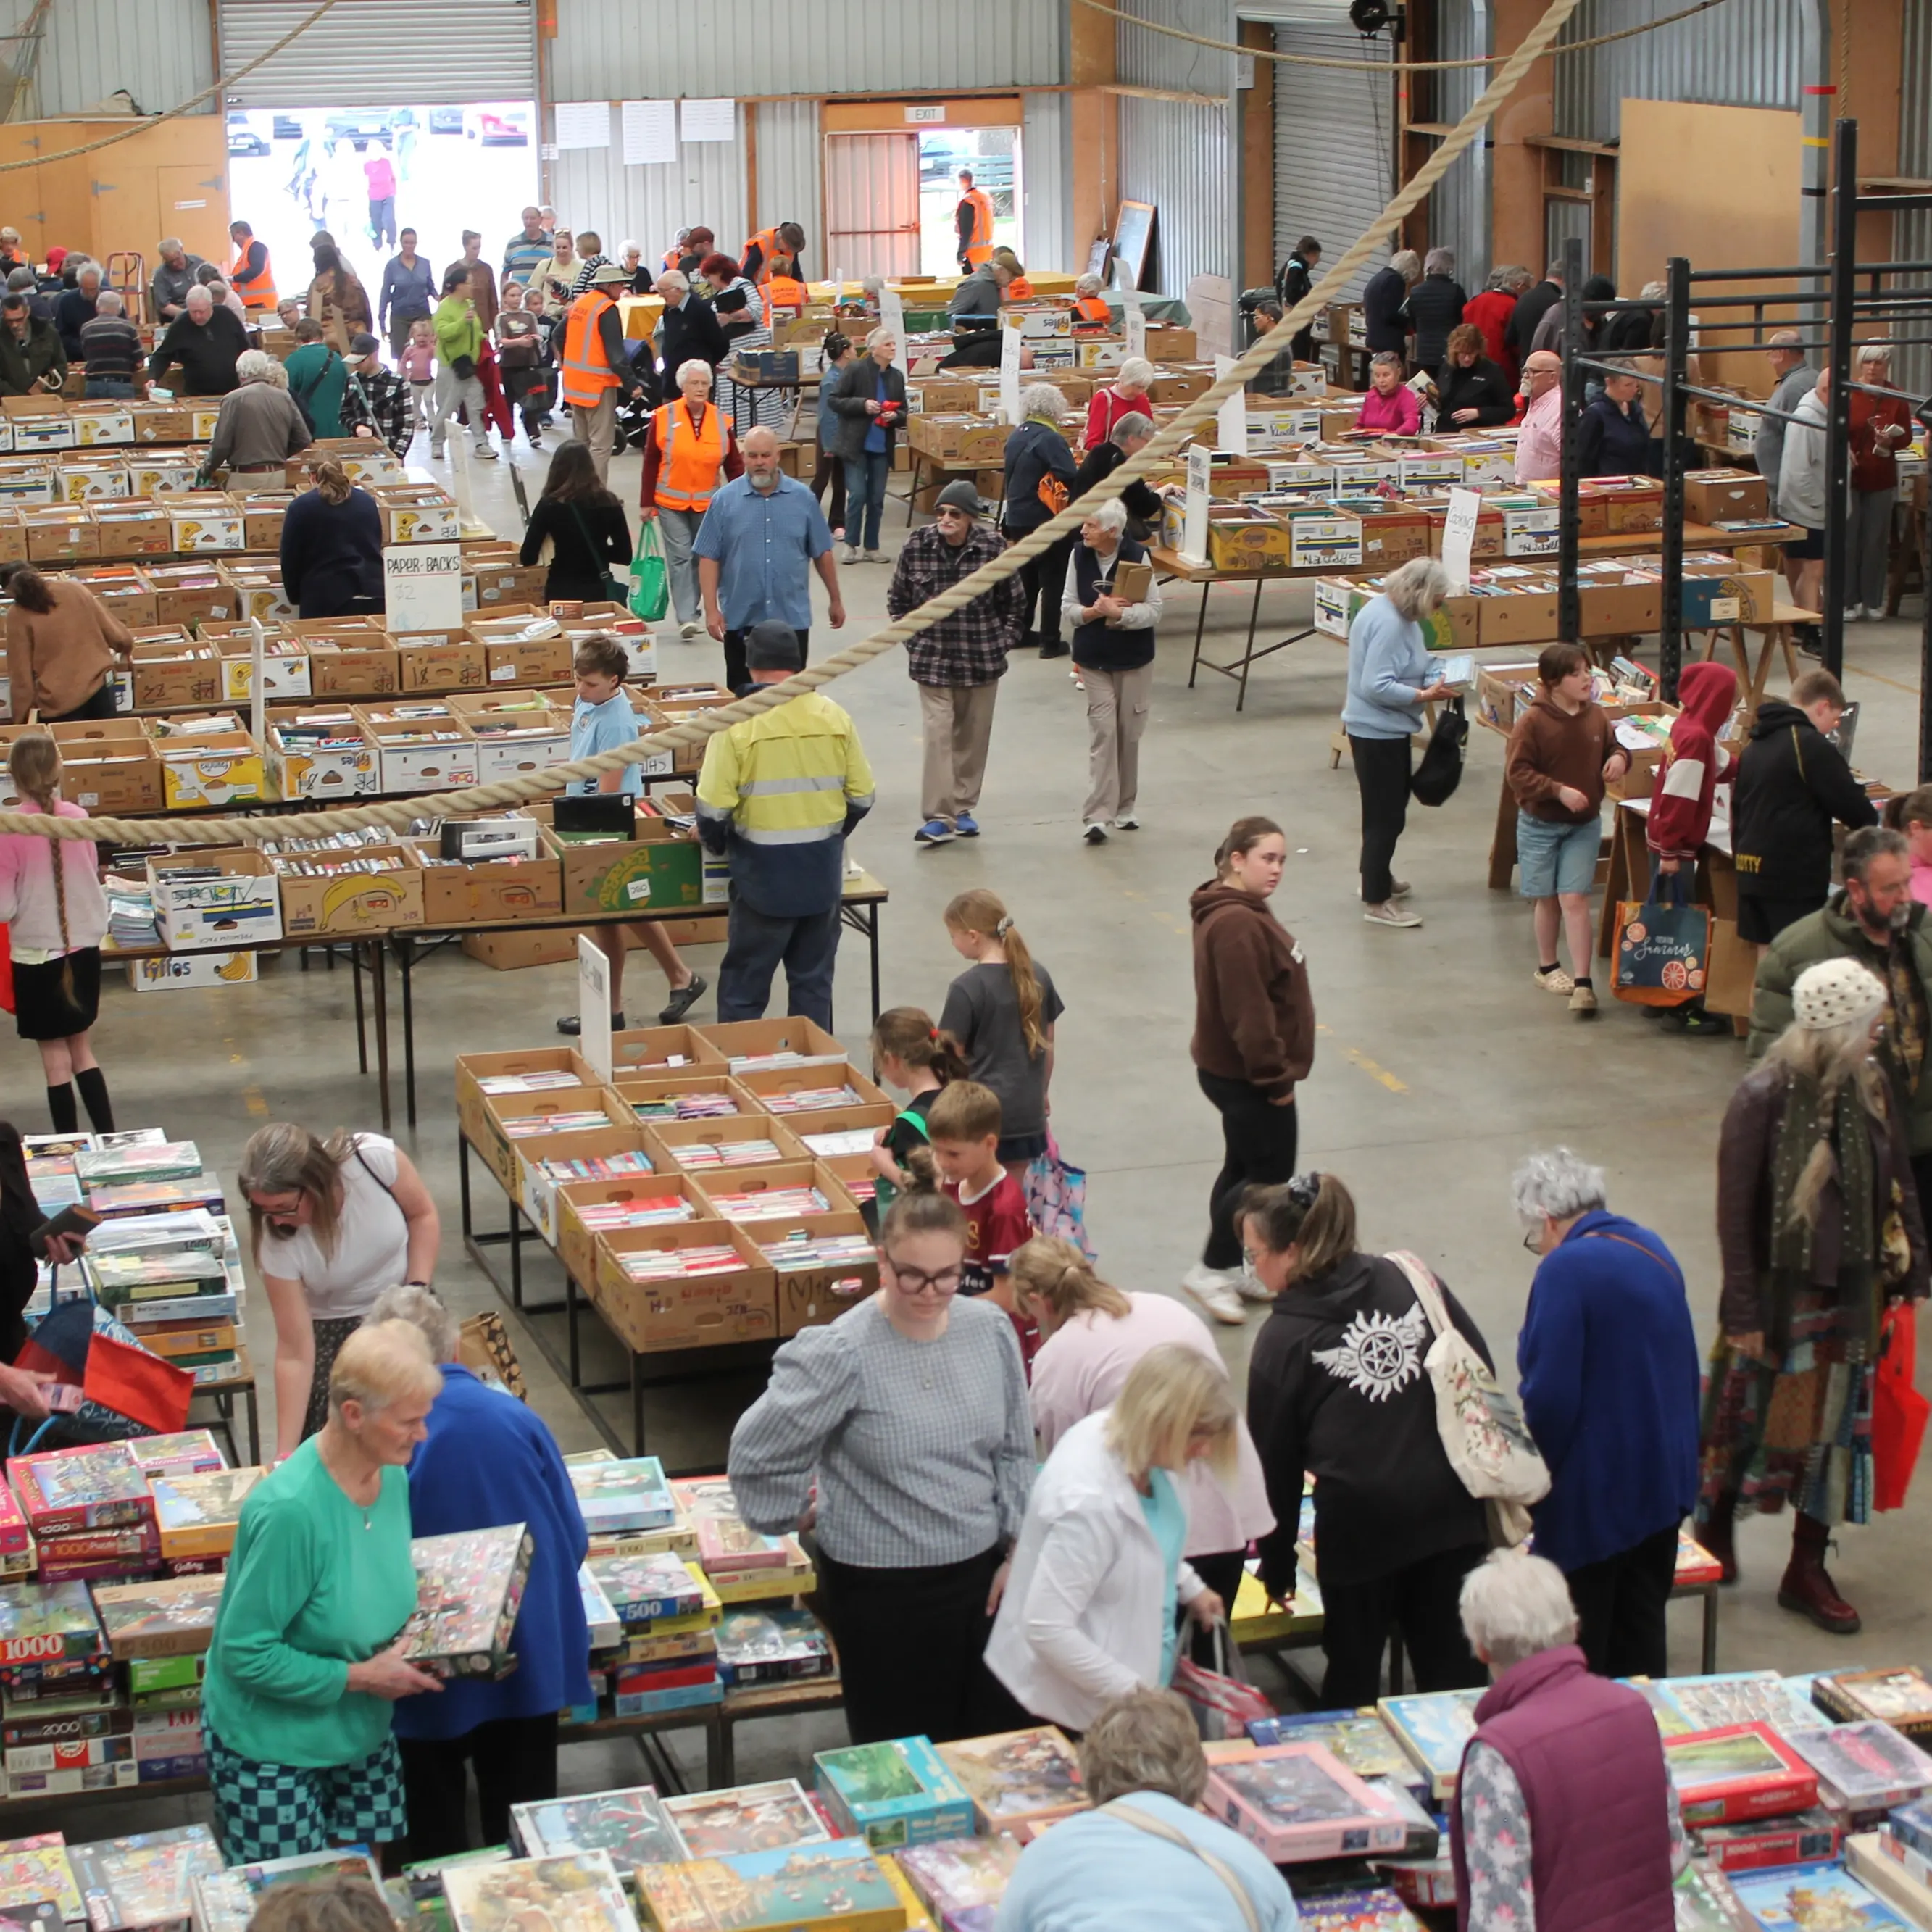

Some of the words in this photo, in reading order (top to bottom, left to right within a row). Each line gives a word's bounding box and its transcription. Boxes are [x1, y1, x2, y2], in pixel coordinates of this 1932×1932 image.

[915, 108, 936, 120] EXIT
[354, 770, 377, 791] PB
[1633, 936, 1694, 961] Summer
[38, 1523, 72, 1535] 1000
[55, 1542, 90, 1555] 1000
[625, 1601, 662, 1620] 500
[6, 1633, 63, 1660] 1000
[42, 1720, 80, 1736] 2000
